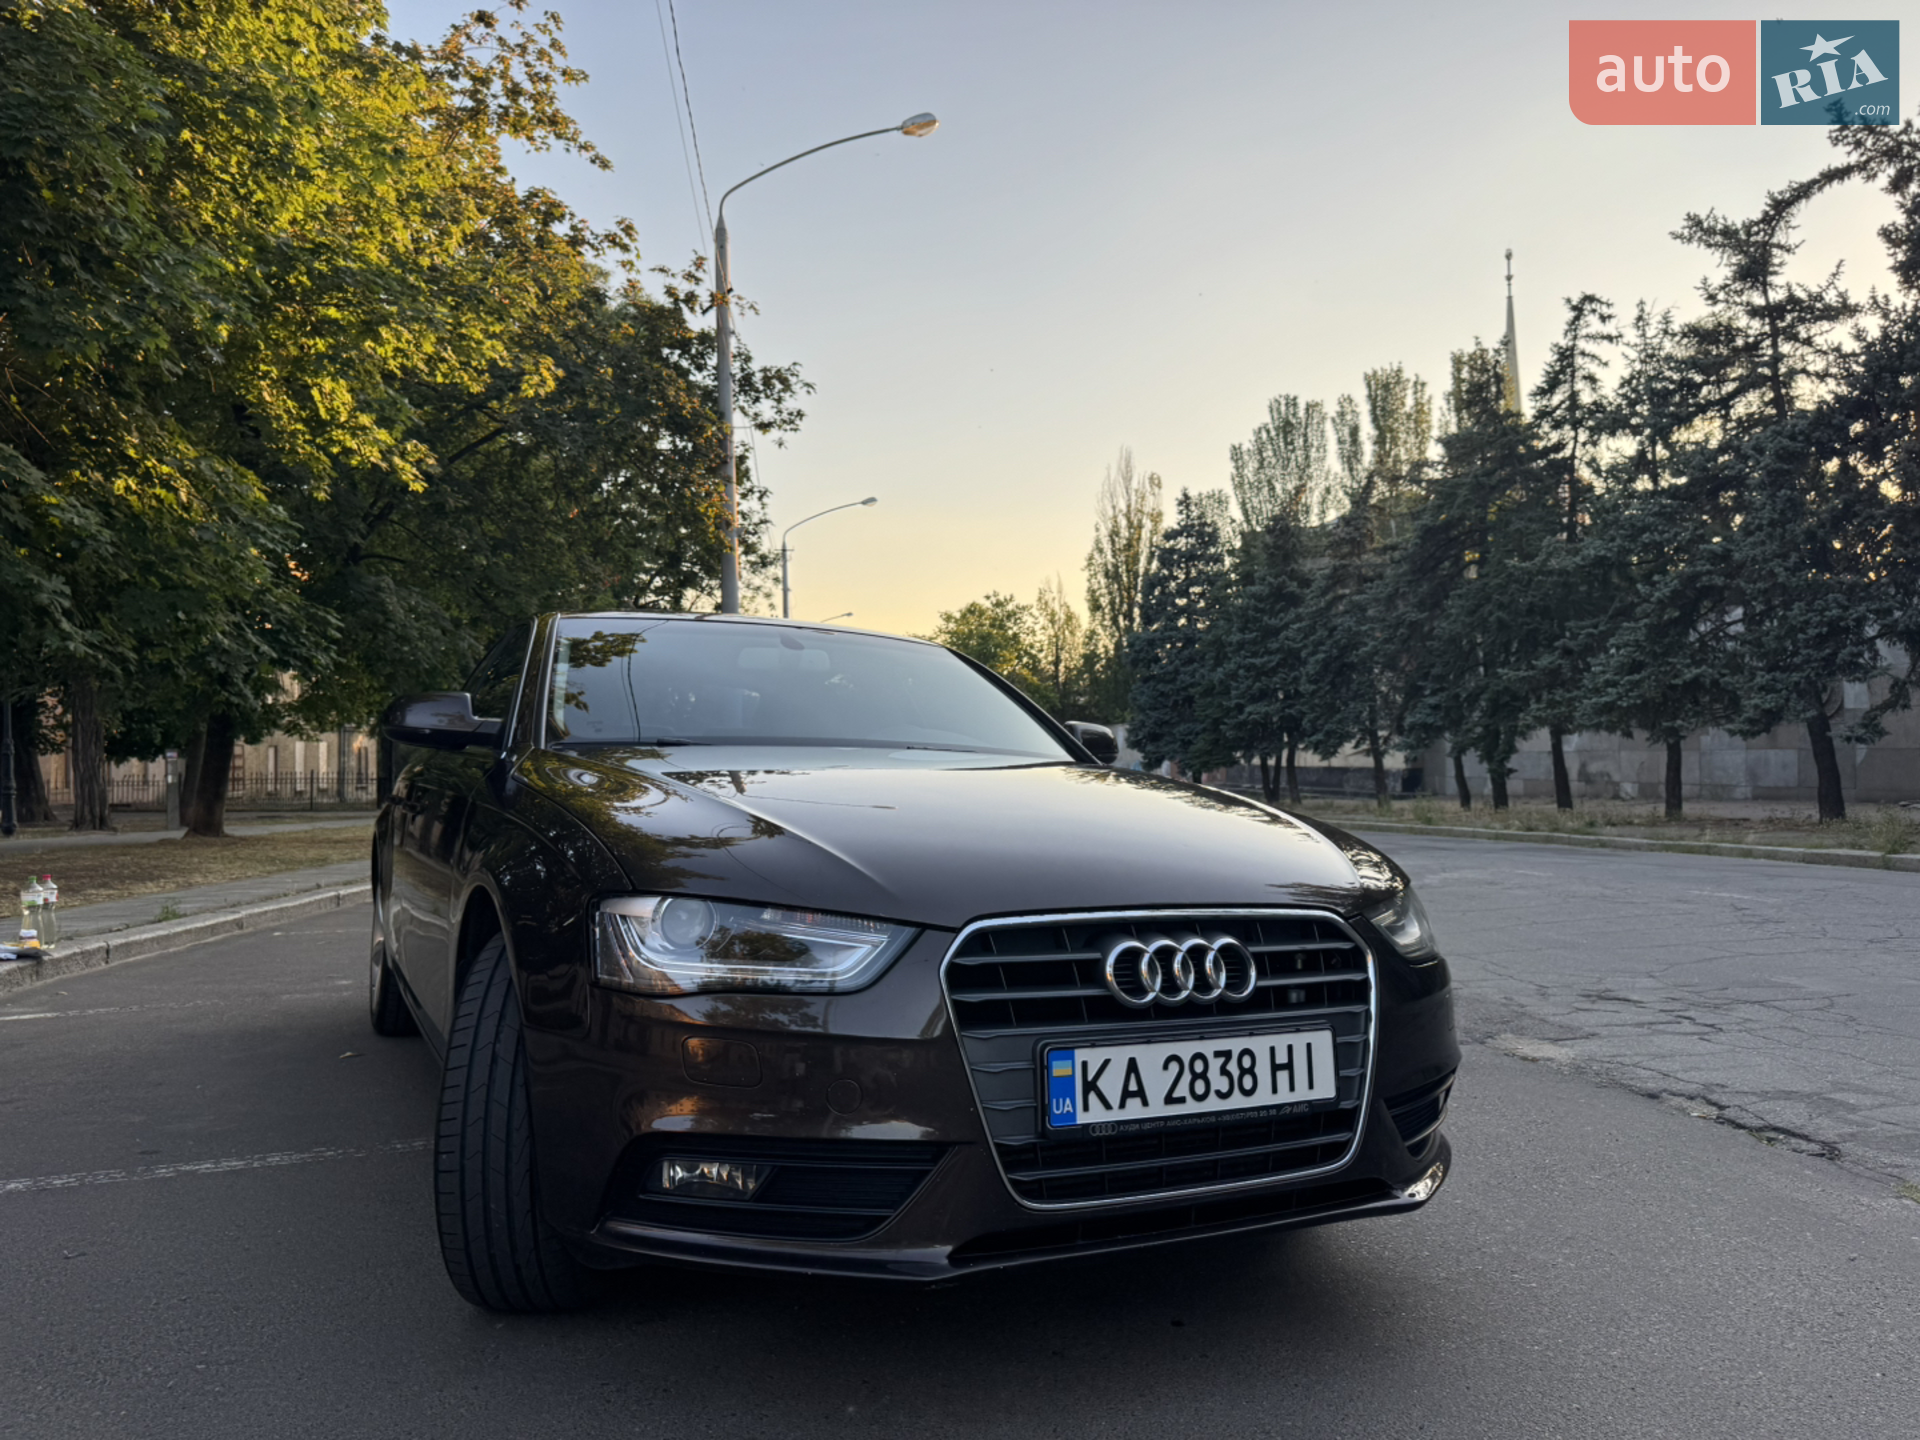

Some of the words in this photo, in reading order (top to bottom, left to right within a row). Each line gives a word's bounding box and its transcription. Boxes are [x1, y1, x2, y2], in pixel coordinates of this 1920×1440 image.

[1081, 1057, 1149, 1112] KA
[1162, 1047, 1258, 1106] 2838
[1269, 1042, 1314, 1094] HI
[1052, 1097, 1074, 1115] UA
